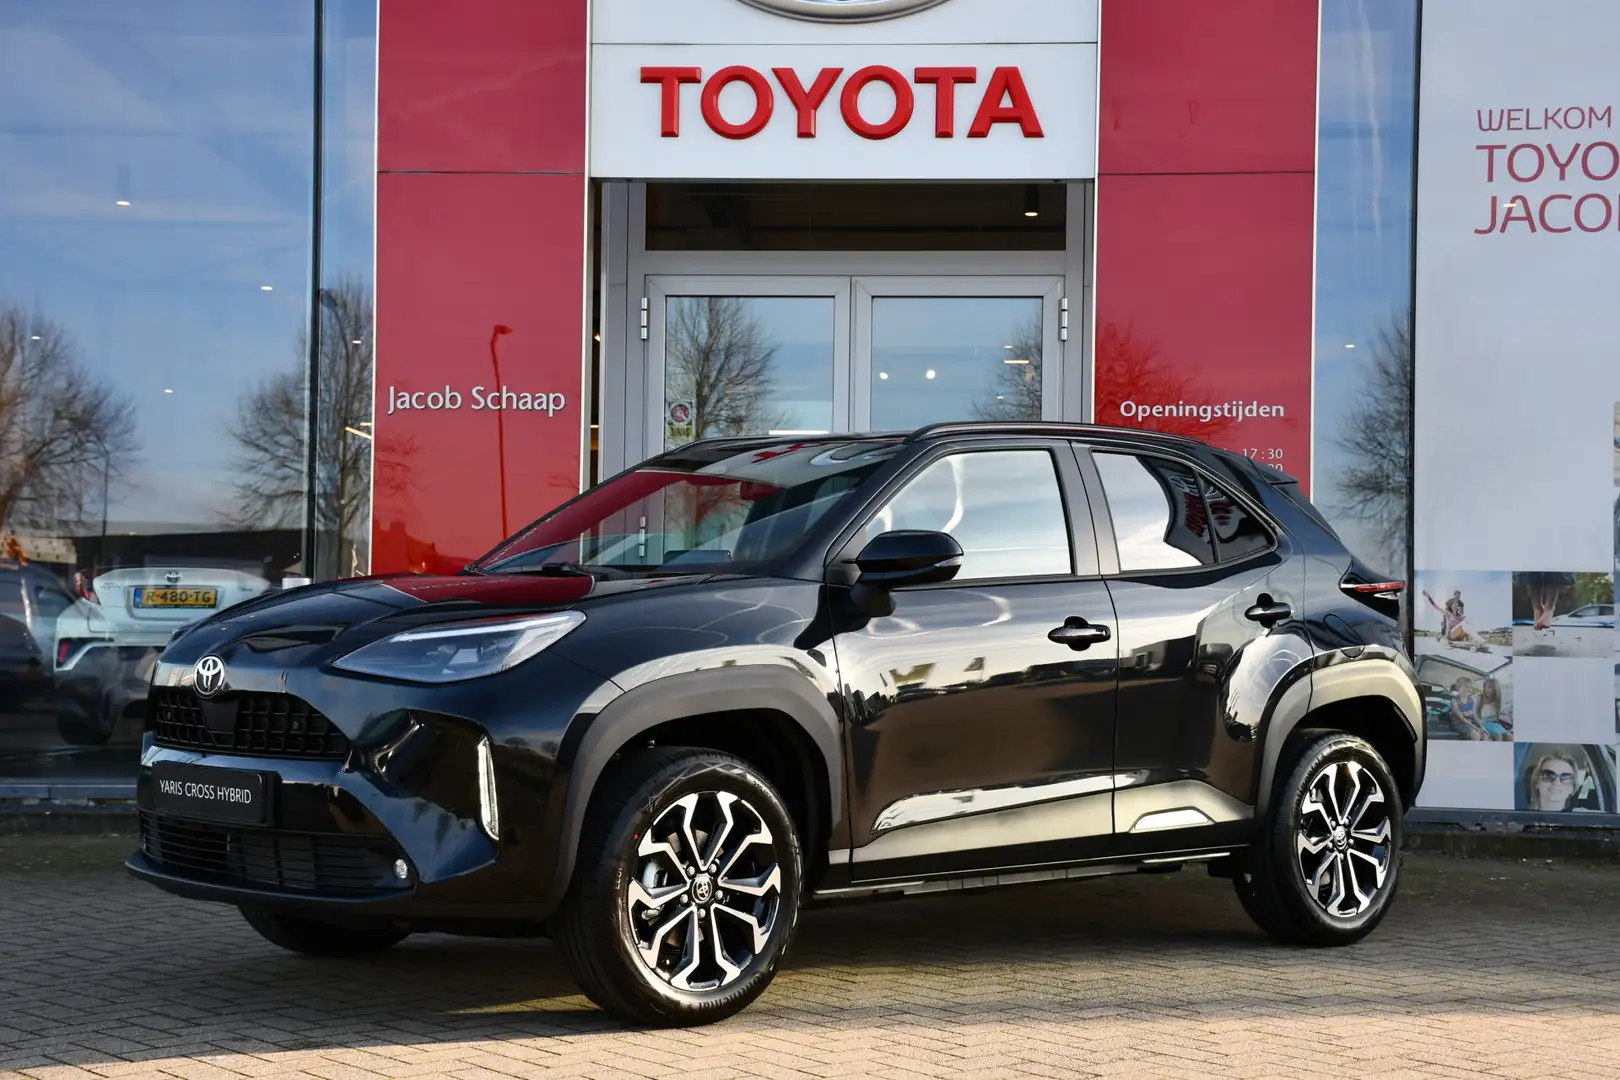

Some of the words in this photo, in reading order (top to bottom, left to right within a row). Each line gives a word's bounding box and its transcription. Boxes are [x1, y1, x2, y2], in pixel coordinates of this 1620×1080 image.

[640, 65, 1045, 140] TOYOTA
[1477, 105, 1612, 131] WELKOM
[1476, 141, 1620, 183] TOYO
[1474, 193, 1620, 234] JACO
[388, 385, 462, 415] Jacob
[471, 386, 566, 417] Schaap
[1120, 400, 1285, 422] Openingstijden
[159, 779, 183, 796] YARIS
[184, 782, 215, 800] CROSS
[217, 787, 252, 804] HYBRID
